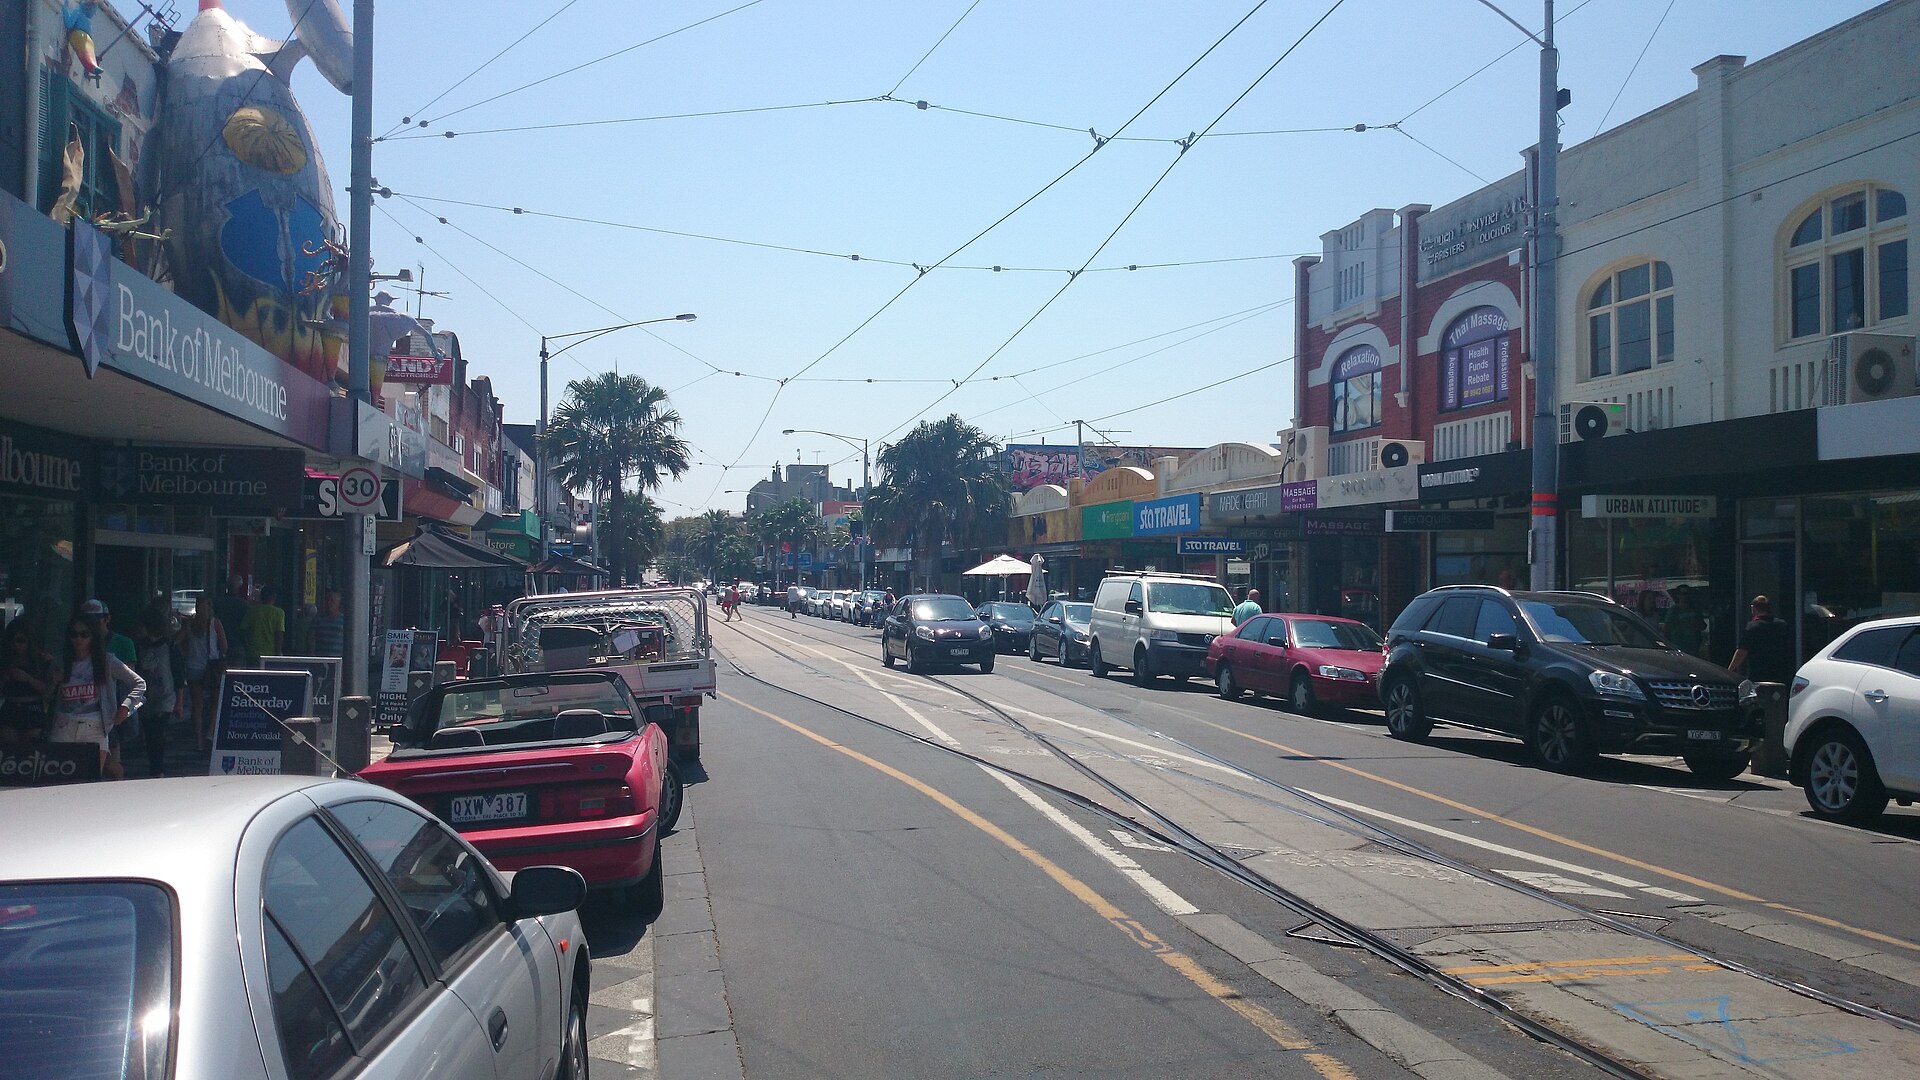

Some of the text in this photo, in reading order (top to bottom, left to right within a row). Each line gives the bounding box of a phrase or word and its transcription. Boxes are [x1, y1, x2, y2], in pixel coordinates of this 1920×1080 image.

[1449, 313, 1509, 344] Thai Massage
[117, 283, 288, 422] Bank of Melbourne
[1468, 346, 1489, 359] Health
[386, 359, 445, 373] ANDY
[1340, 349, 1380, 376] Relaxation
[1468, 359, 1489, 372] Funds
[1501, 341, 1509, 391] Professional
[1447, 356, 1456, 404] Acupressure
[1467, 373, 1490, 386] Rebate
[0, 435, 81, 491] lbourne
[138, 452, 226, 473] Bank of
[138, 474, 267, 496] Melbourne
[1420, 473, 1443, 487] URBAN
[345, 478, 374, 497] 30
[1283, 486, 1316, 498] MASSAGE
[1219, 492, 1268, 512] MADE EARTH
[1605, 499, 1700, 514] URBAN ATTITUDE
[1155, 503, 1191, 528] TRAVEL
[1307, 520, 1370, 531] MASSAGE
[1204, 541, 1241, 551] TRAVEL
[233, 682, 269, 694] Open
[231, 695, 293, 711] Saturday
[379, 693, 407, 701] HIGHL
[379, 713, 403, 723] Only
[227, 731, 248, 740] Now
[237, 756, 275, 766] Bank of
[236, 766, 280, 775] Melbour
[454, 795, 524, 815] QXW 387
